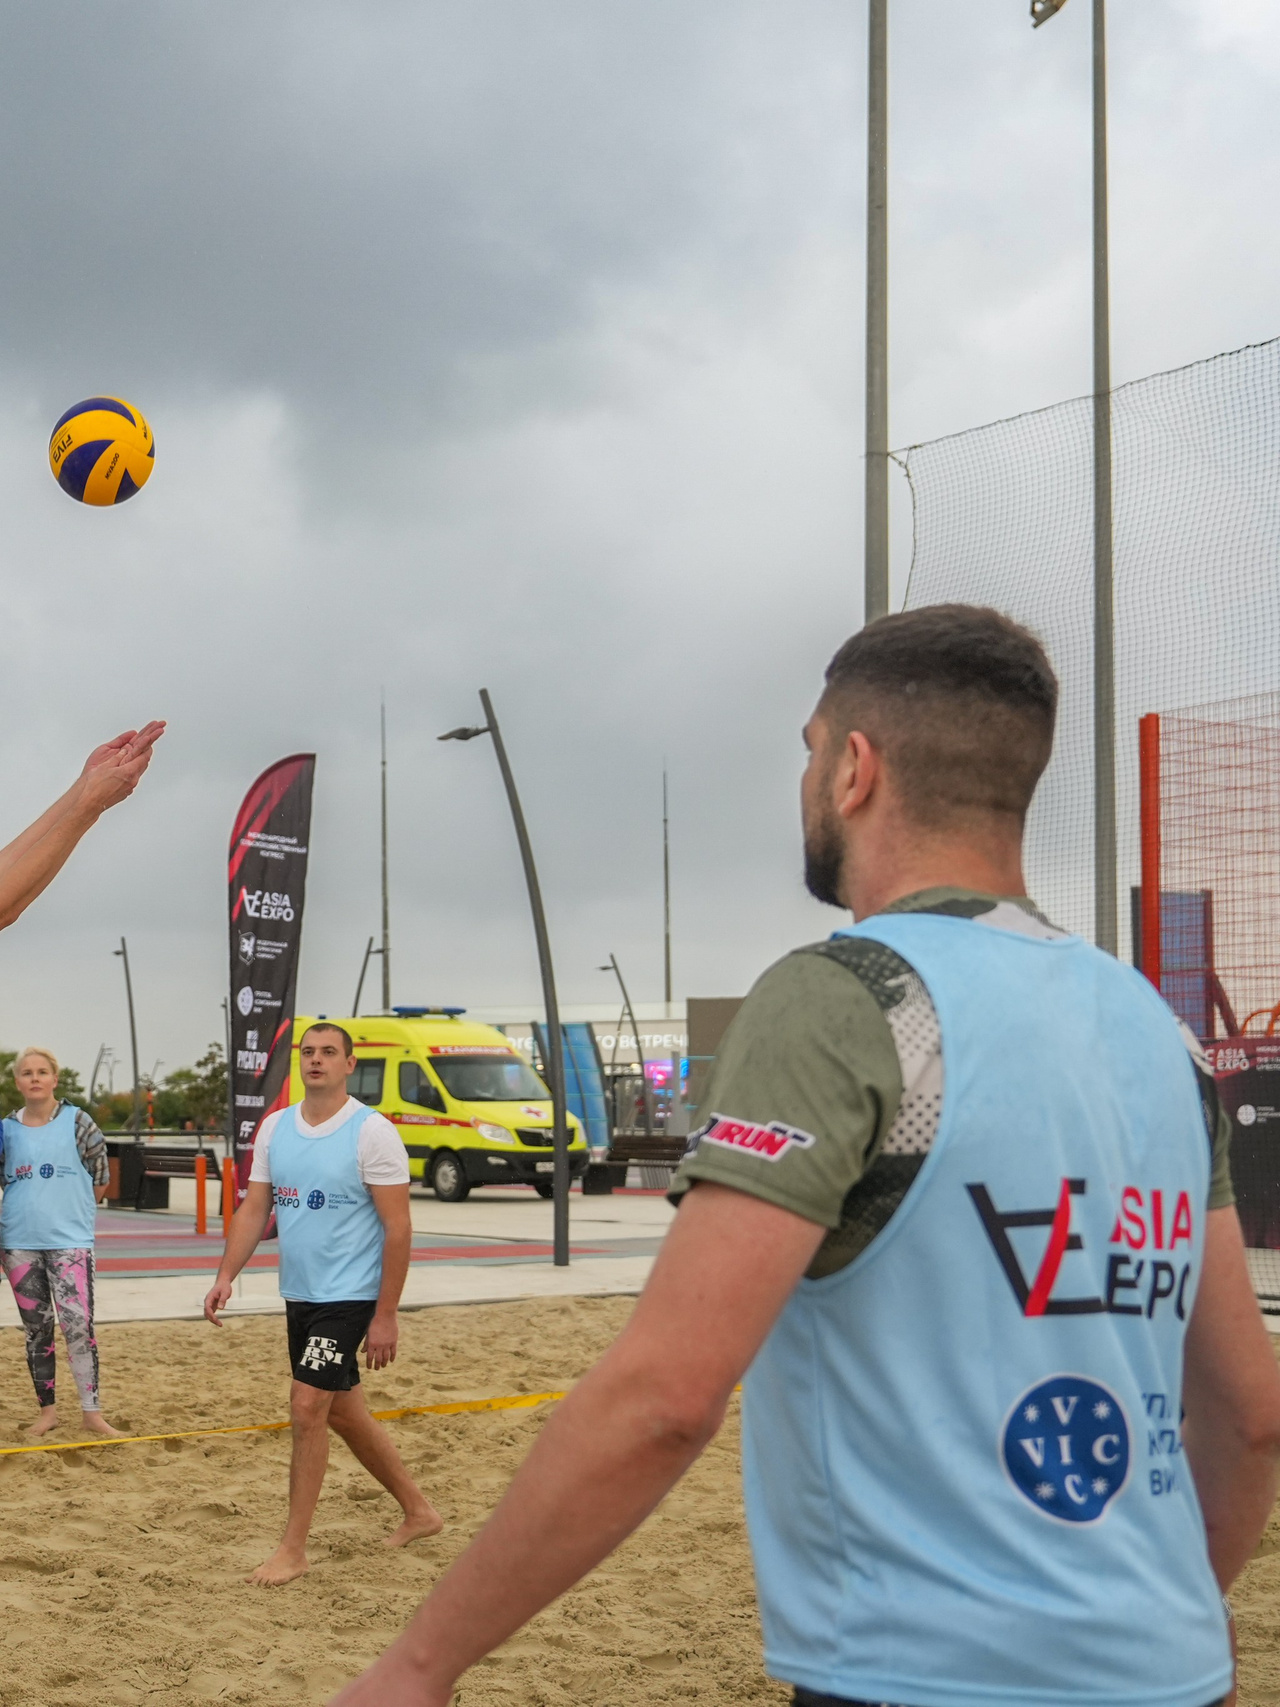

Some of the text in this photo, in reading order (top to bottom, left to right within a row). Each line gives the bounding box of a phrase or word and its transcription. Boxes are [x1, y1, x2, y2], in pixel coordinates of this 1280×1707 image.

[53, 434, 73, 463] FIVB
[262, 891, 291, 907] ASIA
[261, 905, 294, 922] EXPO
[1217, 1048, 1247, 1059] ASIA
[1216, 1058, 1250, 1071] EXPO
[717, 1119, 789, 1157] RUN
[277, 1186, 298, 1197] ASIA
[278, 1196, 300, 1208] EXPO
[307, 1335, 338, 1351] TE
[299, 1355, 326, 1371] IT
[303, 1346, 345, 1365] RM
